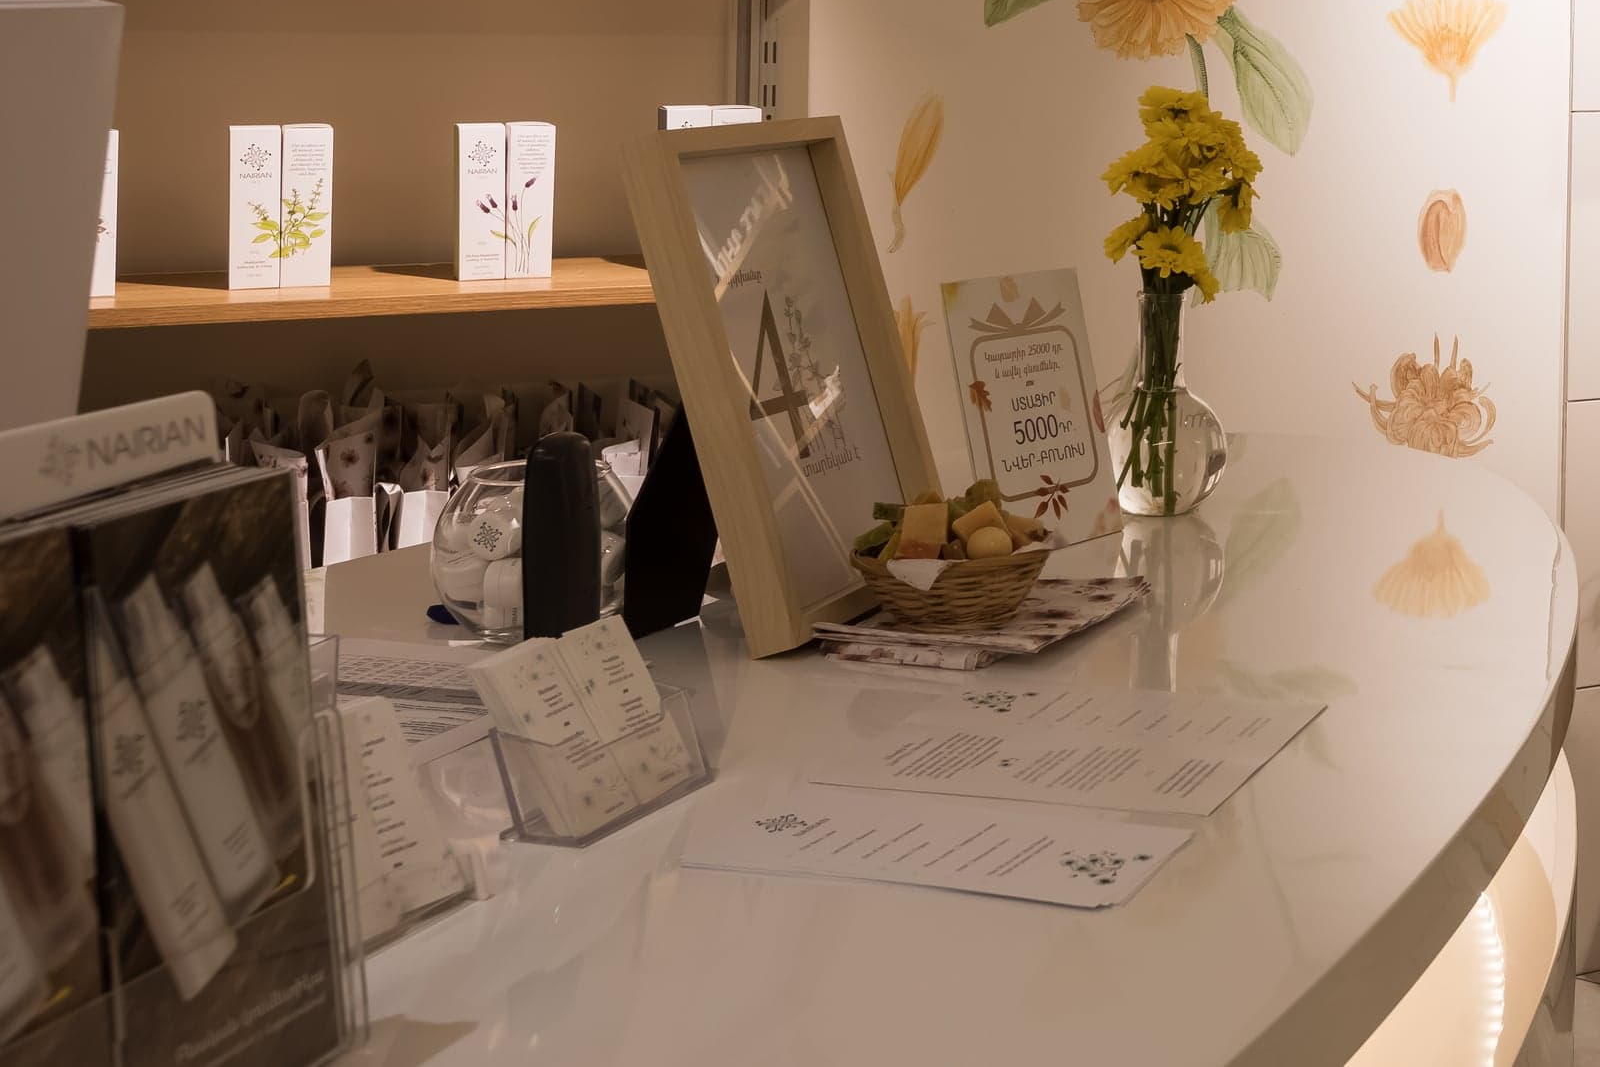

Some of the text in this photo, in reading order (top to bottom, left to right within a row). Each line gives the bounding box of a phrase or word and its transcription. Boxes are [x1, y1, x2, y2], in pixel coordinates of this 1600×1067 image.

[1028, 342, 1050, 356] 25000
[749, 288, 811, 459] 4
[1011, 390, 1057, 411] ՍՏԱՑԻՐ
[86, 414, 207, 470] NAIRIAN
